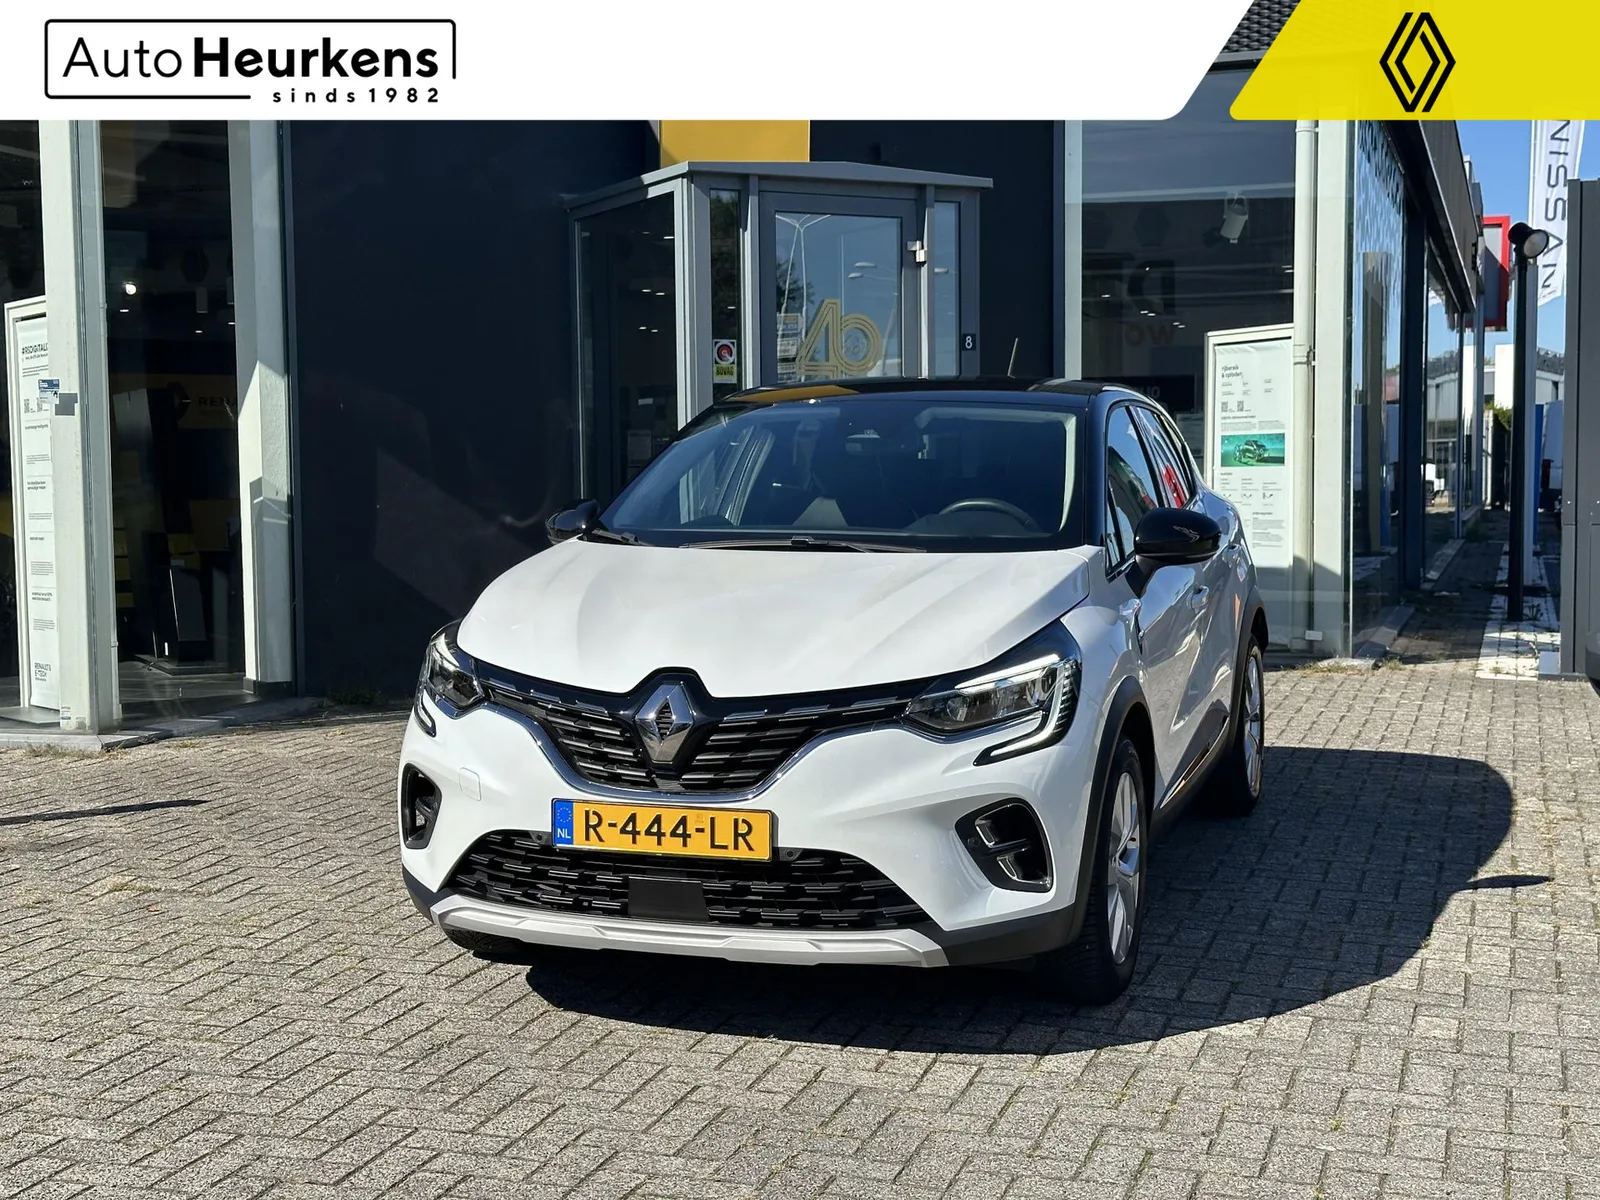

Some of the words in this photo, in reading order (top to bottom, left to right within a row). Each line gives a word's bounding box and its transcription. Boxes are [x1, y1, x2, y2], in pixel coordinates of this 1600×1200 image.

[1541, 120, 1571, 289] NISSAN
[965, 335, 973, 349] 8
[557, 827, 571, 839] NL
[584, 809, 755, 852] R-444-LR
